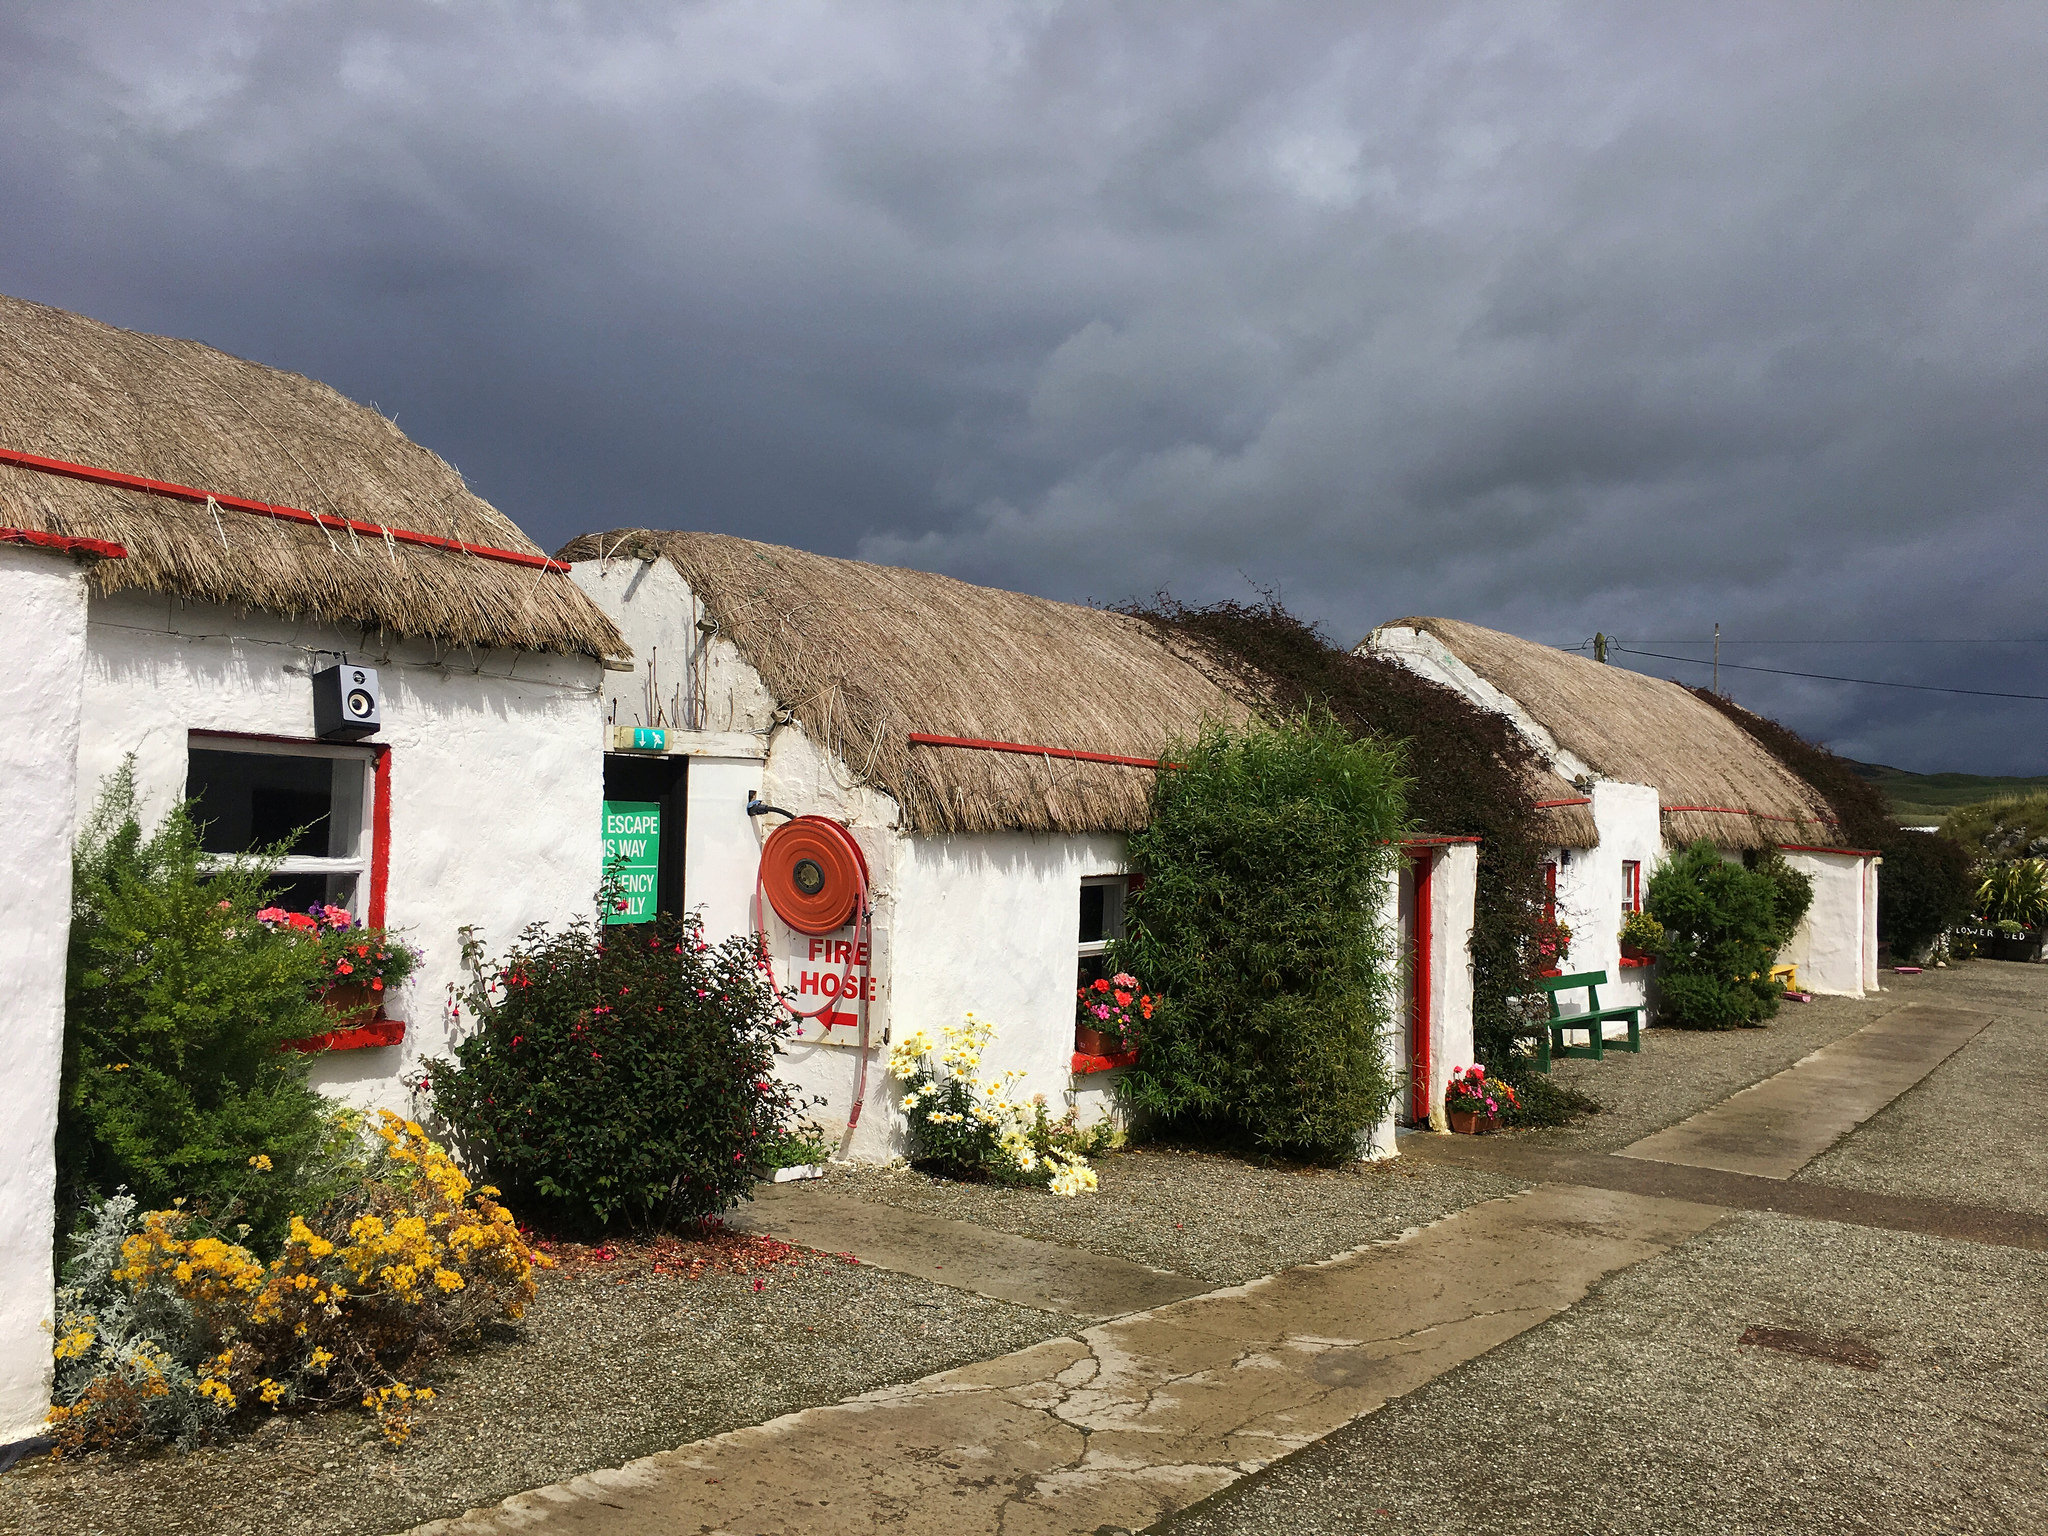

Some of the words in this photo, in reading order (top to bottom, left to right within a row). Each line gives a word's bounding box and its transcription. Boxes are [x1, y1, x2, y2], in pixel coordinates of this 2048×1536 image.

[607, 815, 658, 834] ESCAPE
[618, 839, 648, 858] WAY
[808, 938, 869, 966] FIRE
[800, 971, 877, 1001] HOSE
